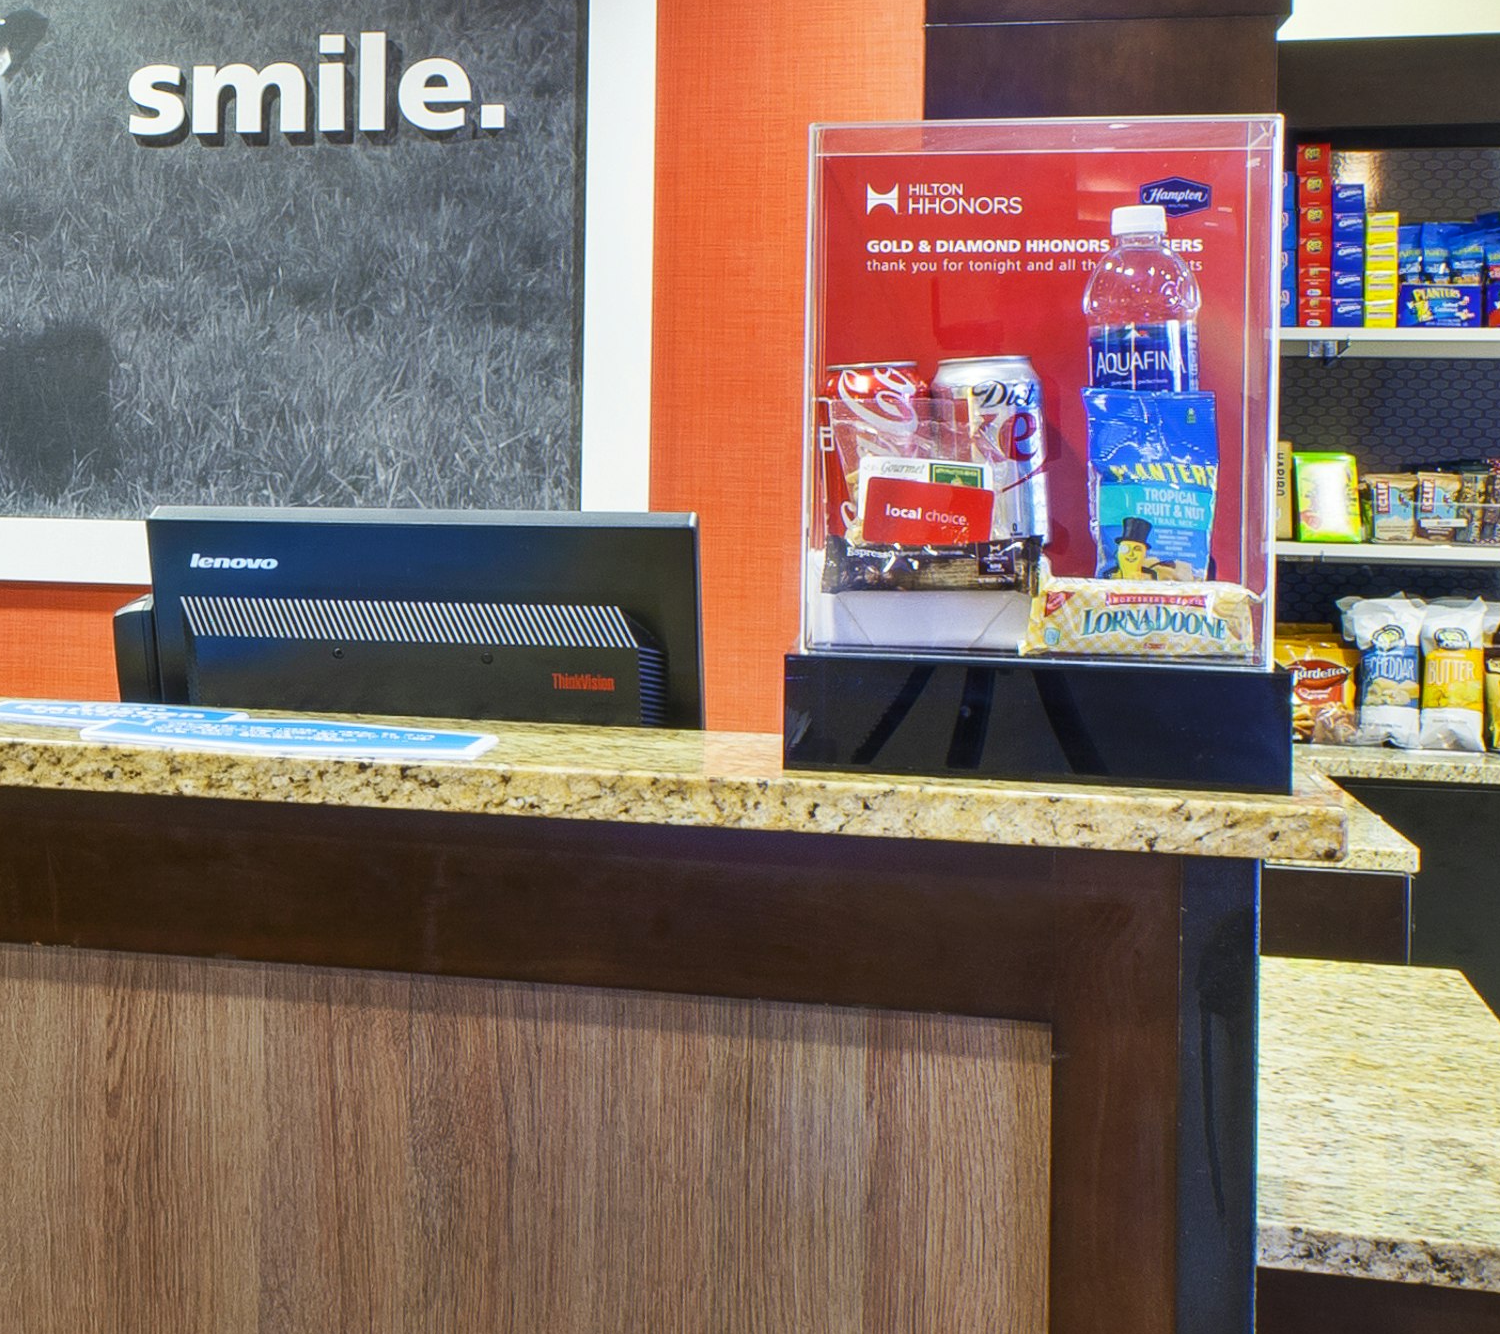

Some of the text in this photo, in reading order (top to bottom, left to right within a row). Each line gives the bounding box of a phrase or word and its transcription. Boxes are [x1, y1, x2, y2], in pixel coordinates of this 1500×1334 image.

[128, 31, 506, 136] smile.
[908, 183, 964, 196] HILTON
[1143, 188, 1208, 204] Hampton
[908, 196, 1023, 215] HHONORS
[866, 239, 914, 253] GOLD
[918, 240, 932, 253] &
[935, 239, 1021, 253] DIAMOND
[1026, 239, 1111, 253] HHONORS
[866, 259, 906, 272] thank
[911, 262, 937, 275] you
[942, 259, 962, 272] for
[968, 259, 1021, 275] tonight
[1026, 259, 1053, 272] and
[1058, 259, 1076, 272] all
[881, 461, 926, 475] Gourmet
[1144, 488, 1199, 506] TROPICAL
[885, 503, 970, 527] local choice.
[1135, 501, 1206, 520] FRUIT & NUT
[189, 553, 279, 571] lenovo
[1082, 605, 1226, 640] LORNA DOONE
[1427, 658, 1475, 685] BUTTER
[551, 672, 615, 692] ThinkVision
